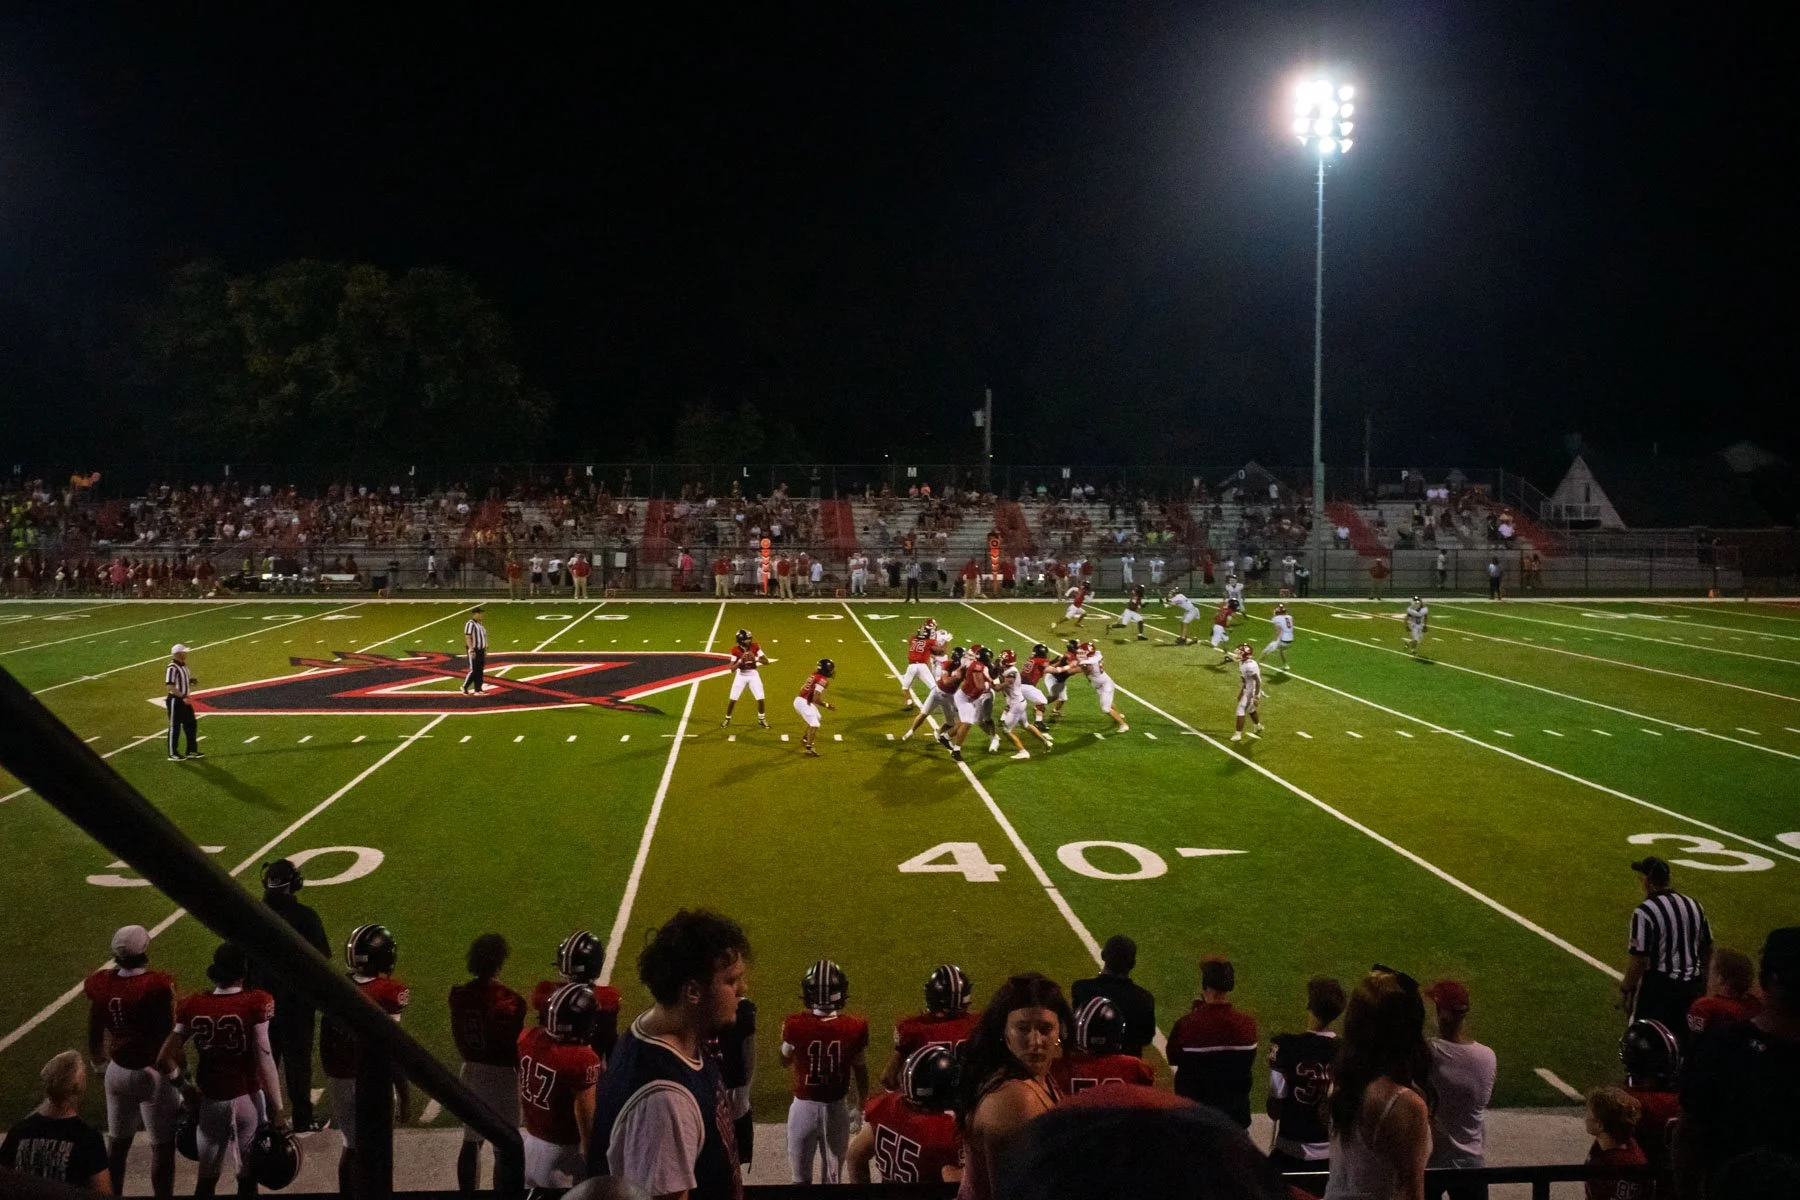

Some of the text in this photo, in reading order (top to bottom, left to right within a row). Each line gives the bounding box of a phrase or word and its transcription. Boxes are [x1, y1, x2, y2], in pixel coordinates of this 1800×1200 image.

[408, 465, 415, 476] J
[586, 466, 594, 476] K
[742, 466, 750, 477] L
[907, 467, 917, 477] M
[1401, 470, 1408, 480] P
[898, 840, 1168, 882] 40
[805, 1040, 843, 1086] 11
[520, 1054, 556, 1111] 17
[876, 1123, 922, 1183] 55
